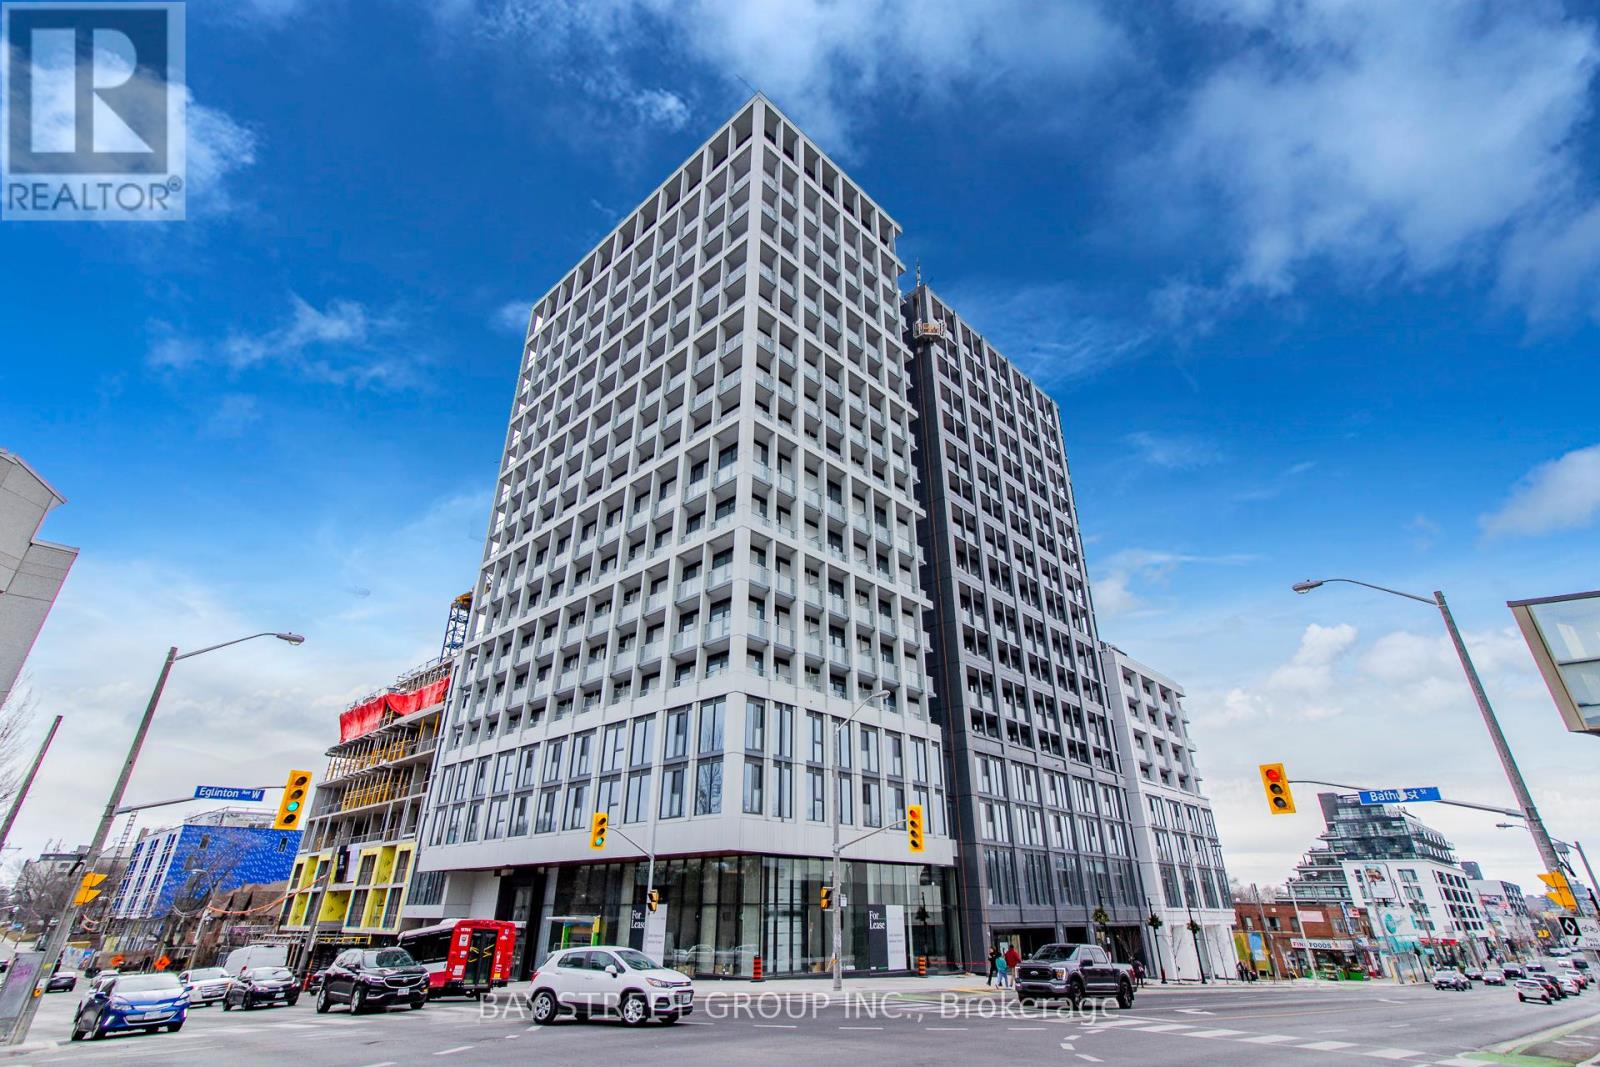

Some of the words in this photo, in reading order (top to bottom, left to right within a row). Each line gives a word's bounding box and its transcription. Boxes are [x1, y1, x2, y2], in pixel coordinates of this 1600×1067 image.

[199, 787, 239, 799] Eglinton
[251, 790, 262, 799] W
[632, 910, 642, 920] For
[869, 910, 880, 920] For
[869, 919, 886, 930] Lease
